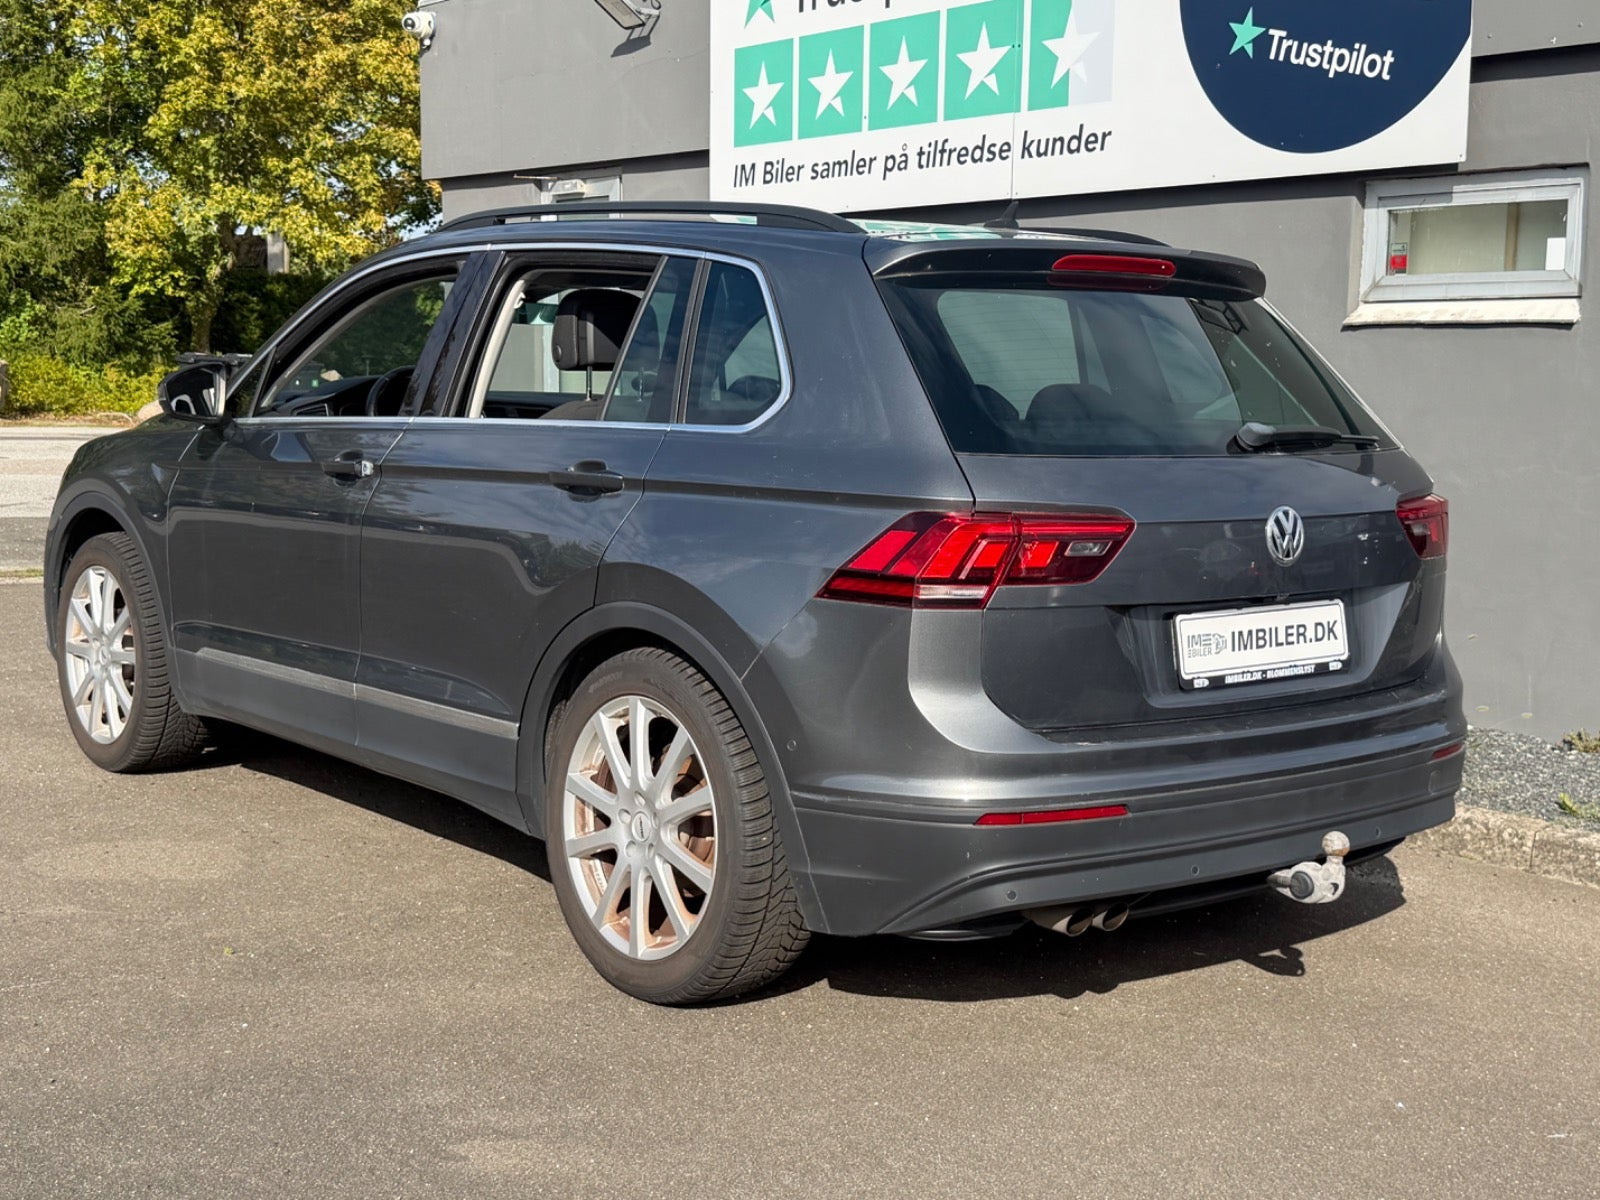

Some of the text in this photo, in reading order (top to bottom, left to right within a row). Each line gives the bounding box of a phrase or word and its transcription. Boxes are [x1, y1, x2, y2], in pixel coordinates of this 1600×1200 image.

[1268, 28, 1395, 81] Trustpilot
[733, 123, 1112, 188] IM Biler samler på tilfredse kunder
[1231, 620, 1339, 653] IMBILER.DK
